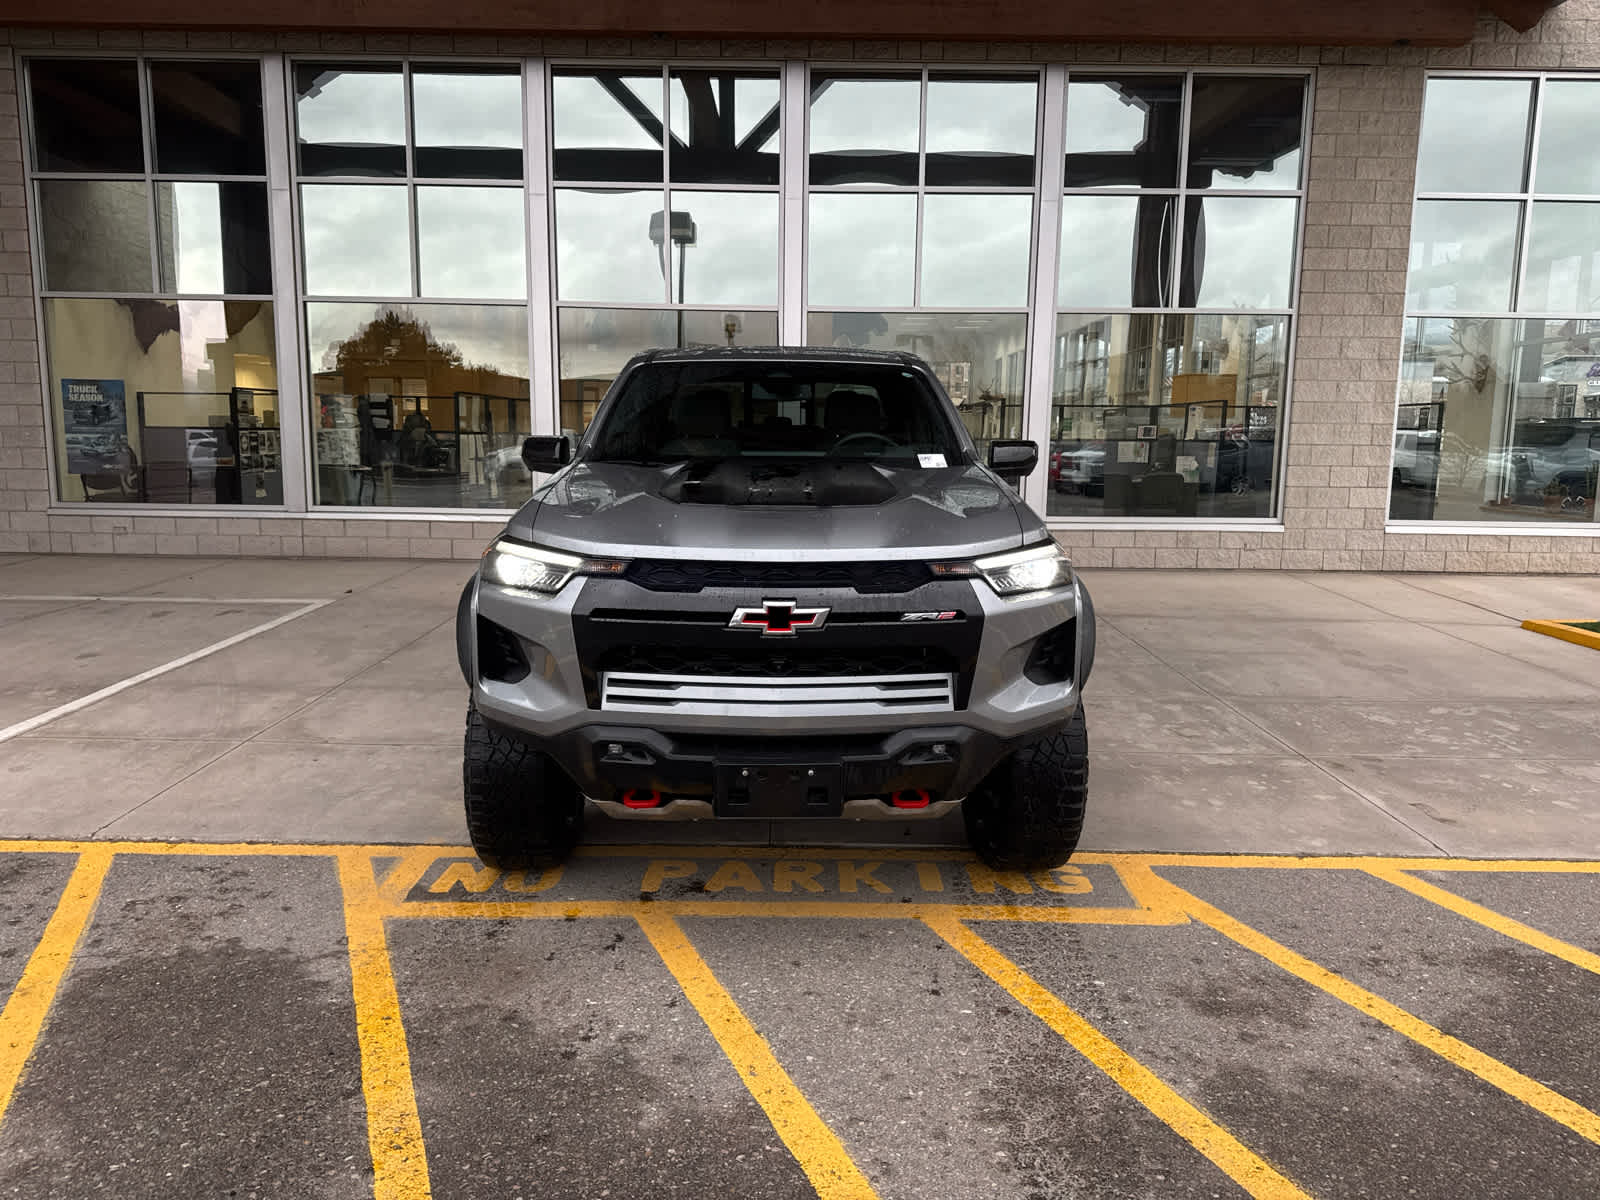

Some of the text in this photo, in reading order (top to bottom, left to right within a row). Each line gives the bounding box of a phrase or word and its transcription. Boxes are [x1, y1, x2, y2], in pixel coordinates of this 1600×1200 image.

[68, 384, 98, 393] TRUCK
[68, 393, 104, 402] SEASON
[640, 860, 1094, 894] PARKING
